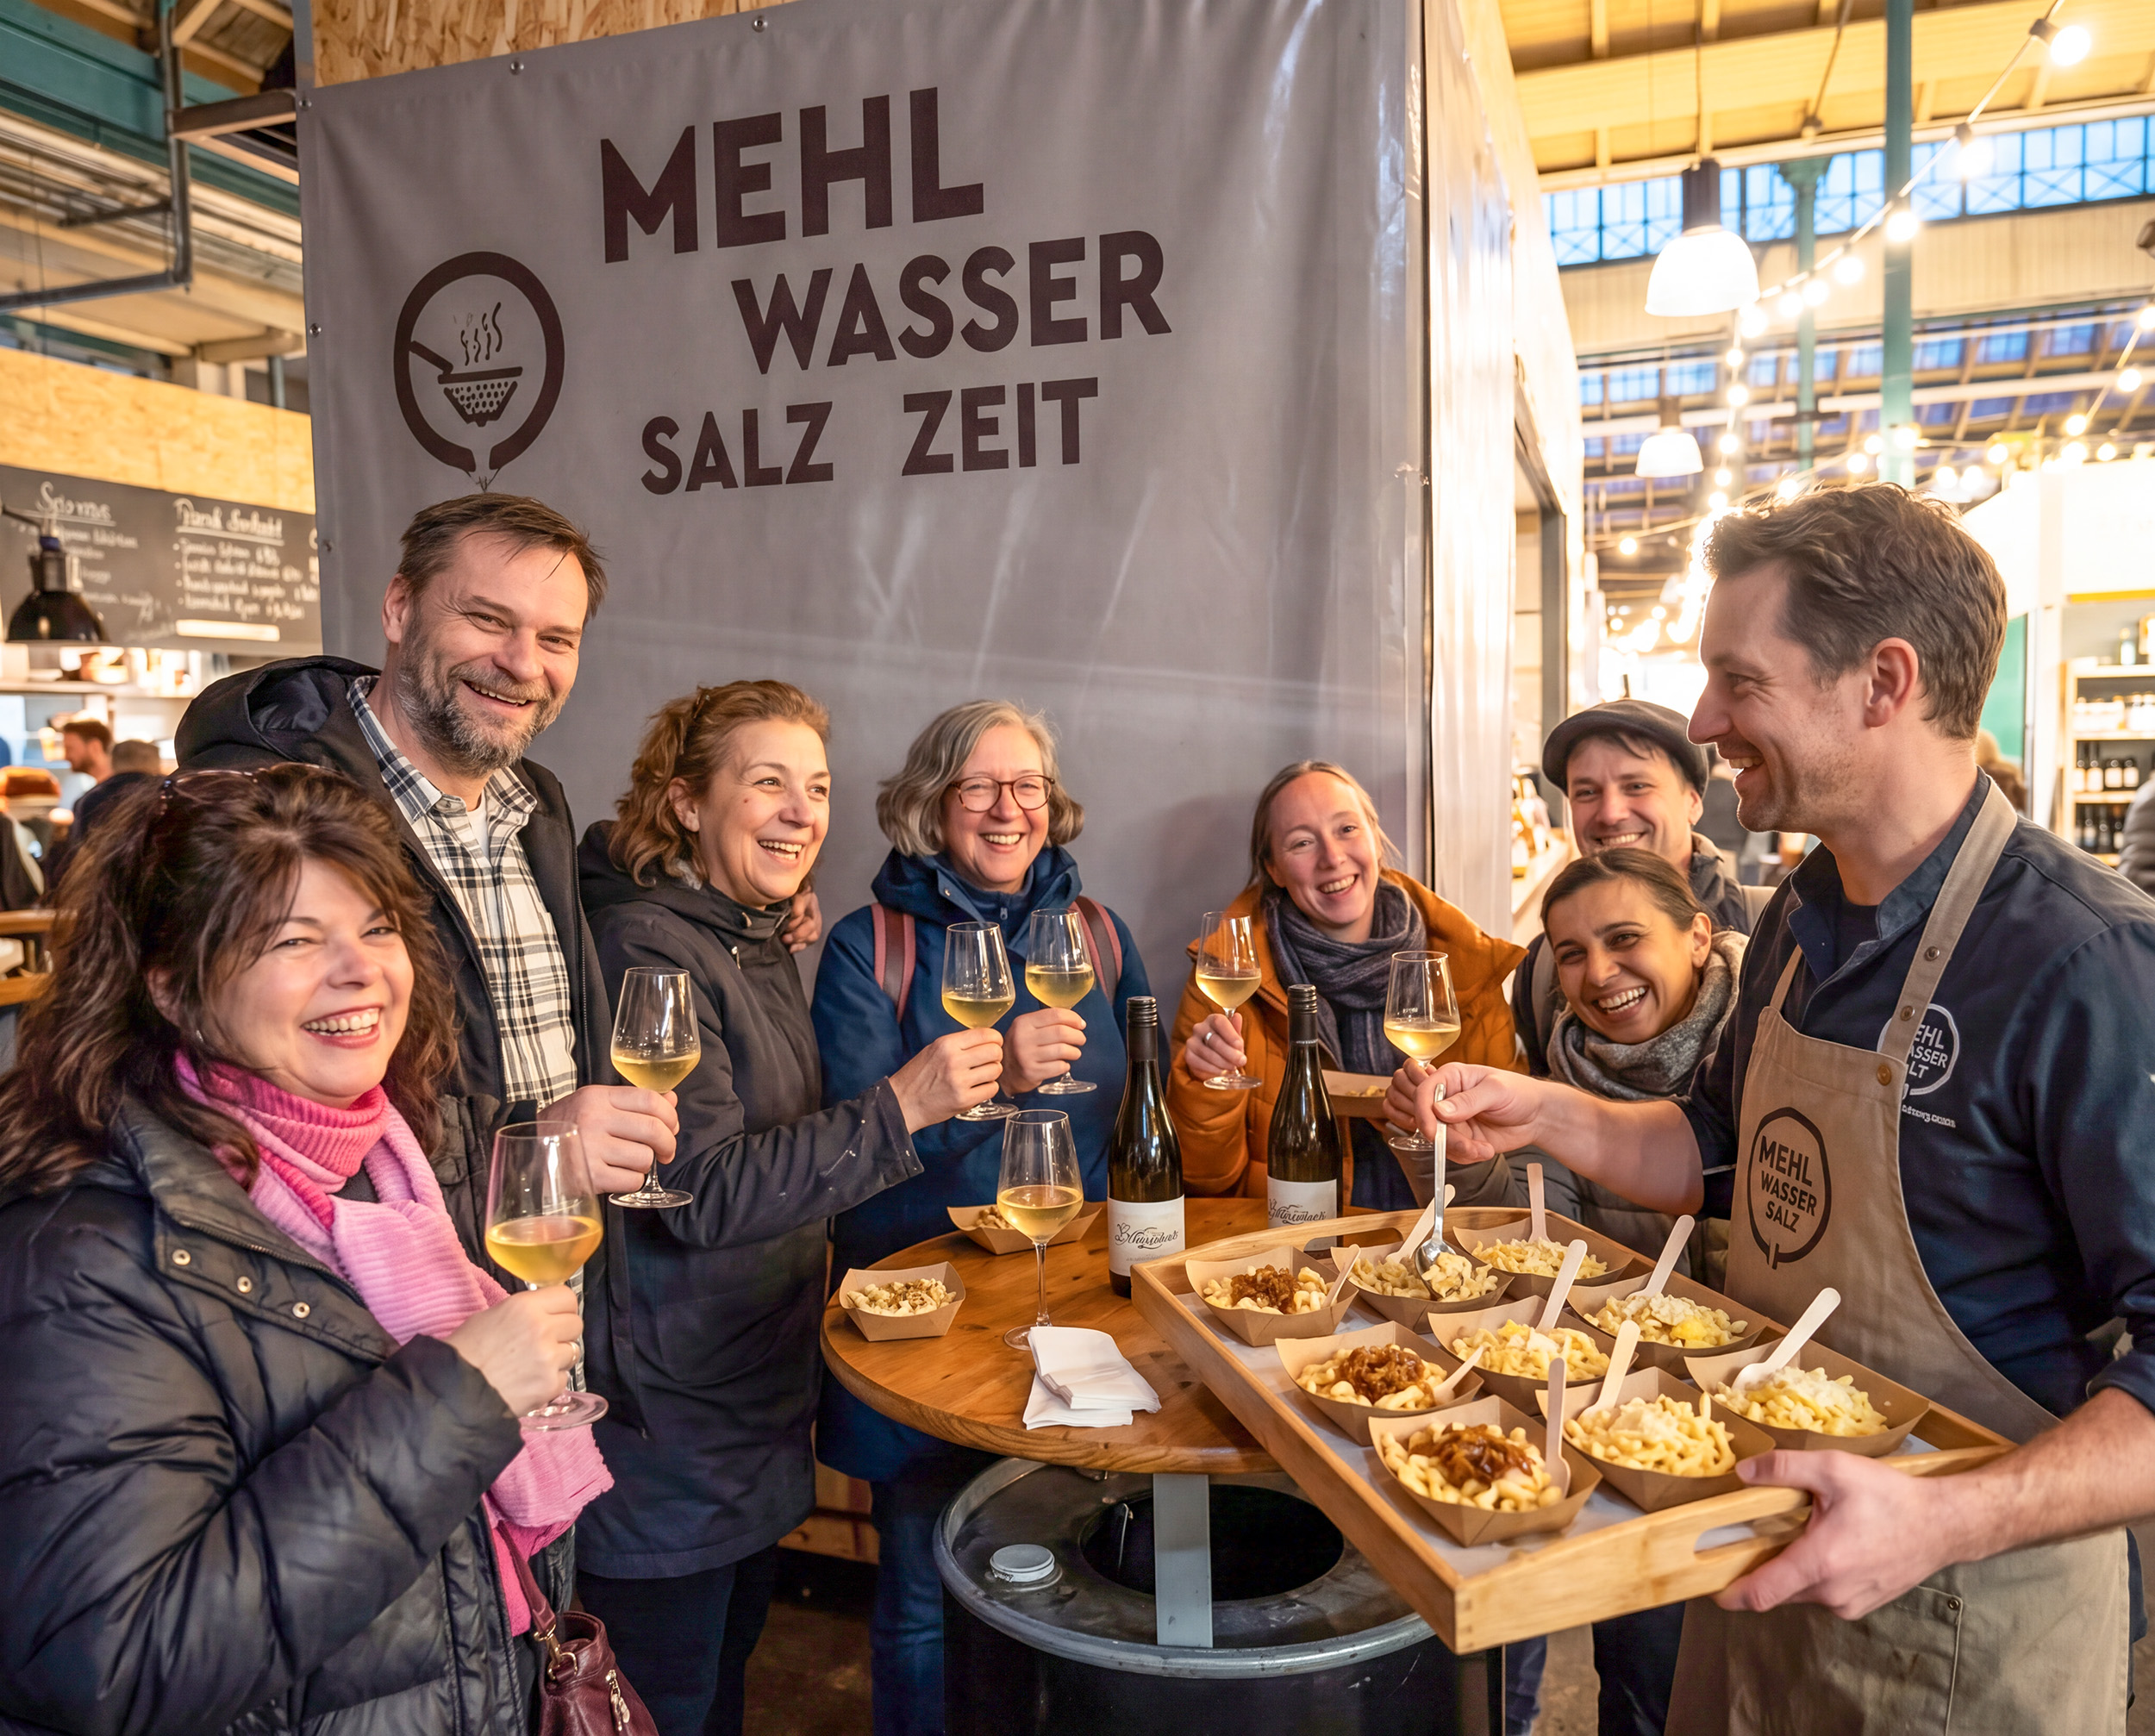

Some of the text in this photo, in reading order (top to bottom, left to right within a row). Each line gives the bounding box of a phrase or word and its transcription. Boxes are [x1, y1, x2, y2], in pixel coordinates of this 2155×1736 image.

[600, 87, 984, 264] MEHL
[731, 230, 1172, 375] WASSER
[640, 377, 1098, 495] SALZ ZEIT
[1910, 1045, 1948, 1068] SSER
[1914, 1024, 1944, 1049] EHL
[1758, 1134, 1813, 1187] MEHL
[1761, 1170, 1818, 1217] WASSER
[1765, 1200, 1800, 1233] SALZ
